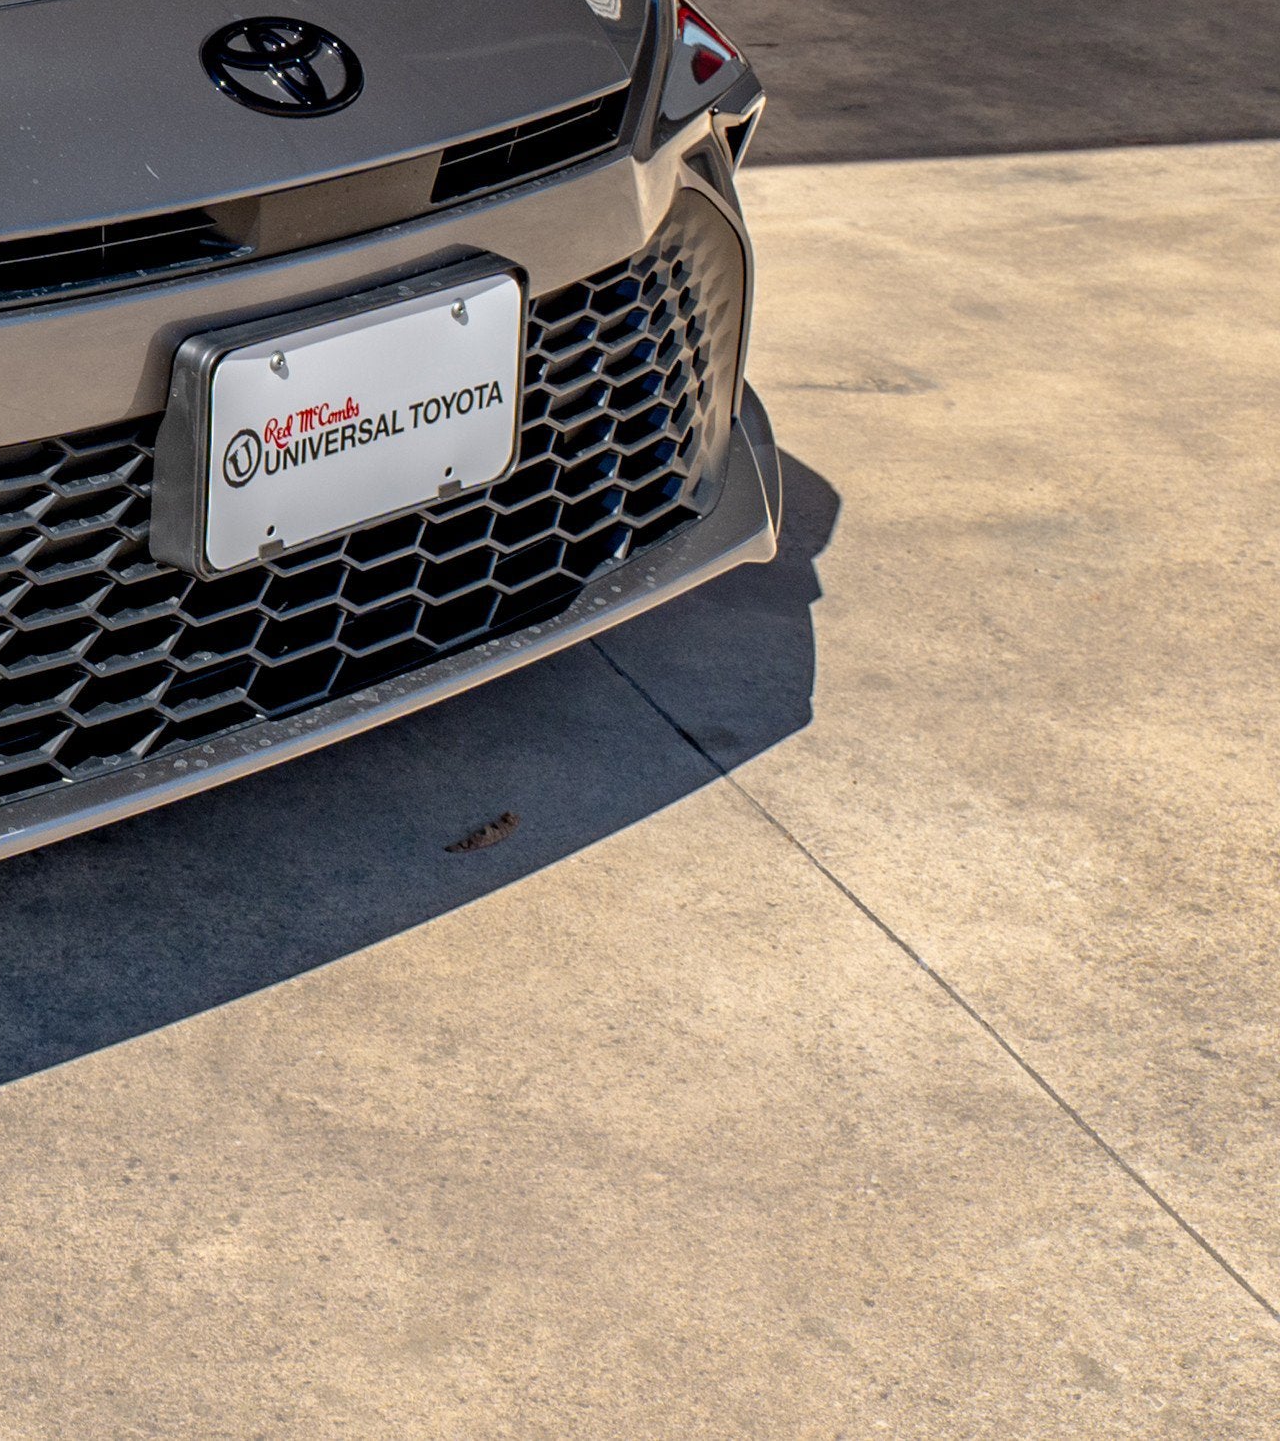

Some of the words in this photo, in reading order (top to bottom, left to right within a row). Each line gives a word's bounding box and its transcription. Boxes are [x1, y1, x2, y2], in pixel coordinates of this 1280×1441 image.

[264, 409, 405, 476] UNIVERSAL
[409, 380, 504, 429] TOYOTA
[264, 414, 293, 449] Red
